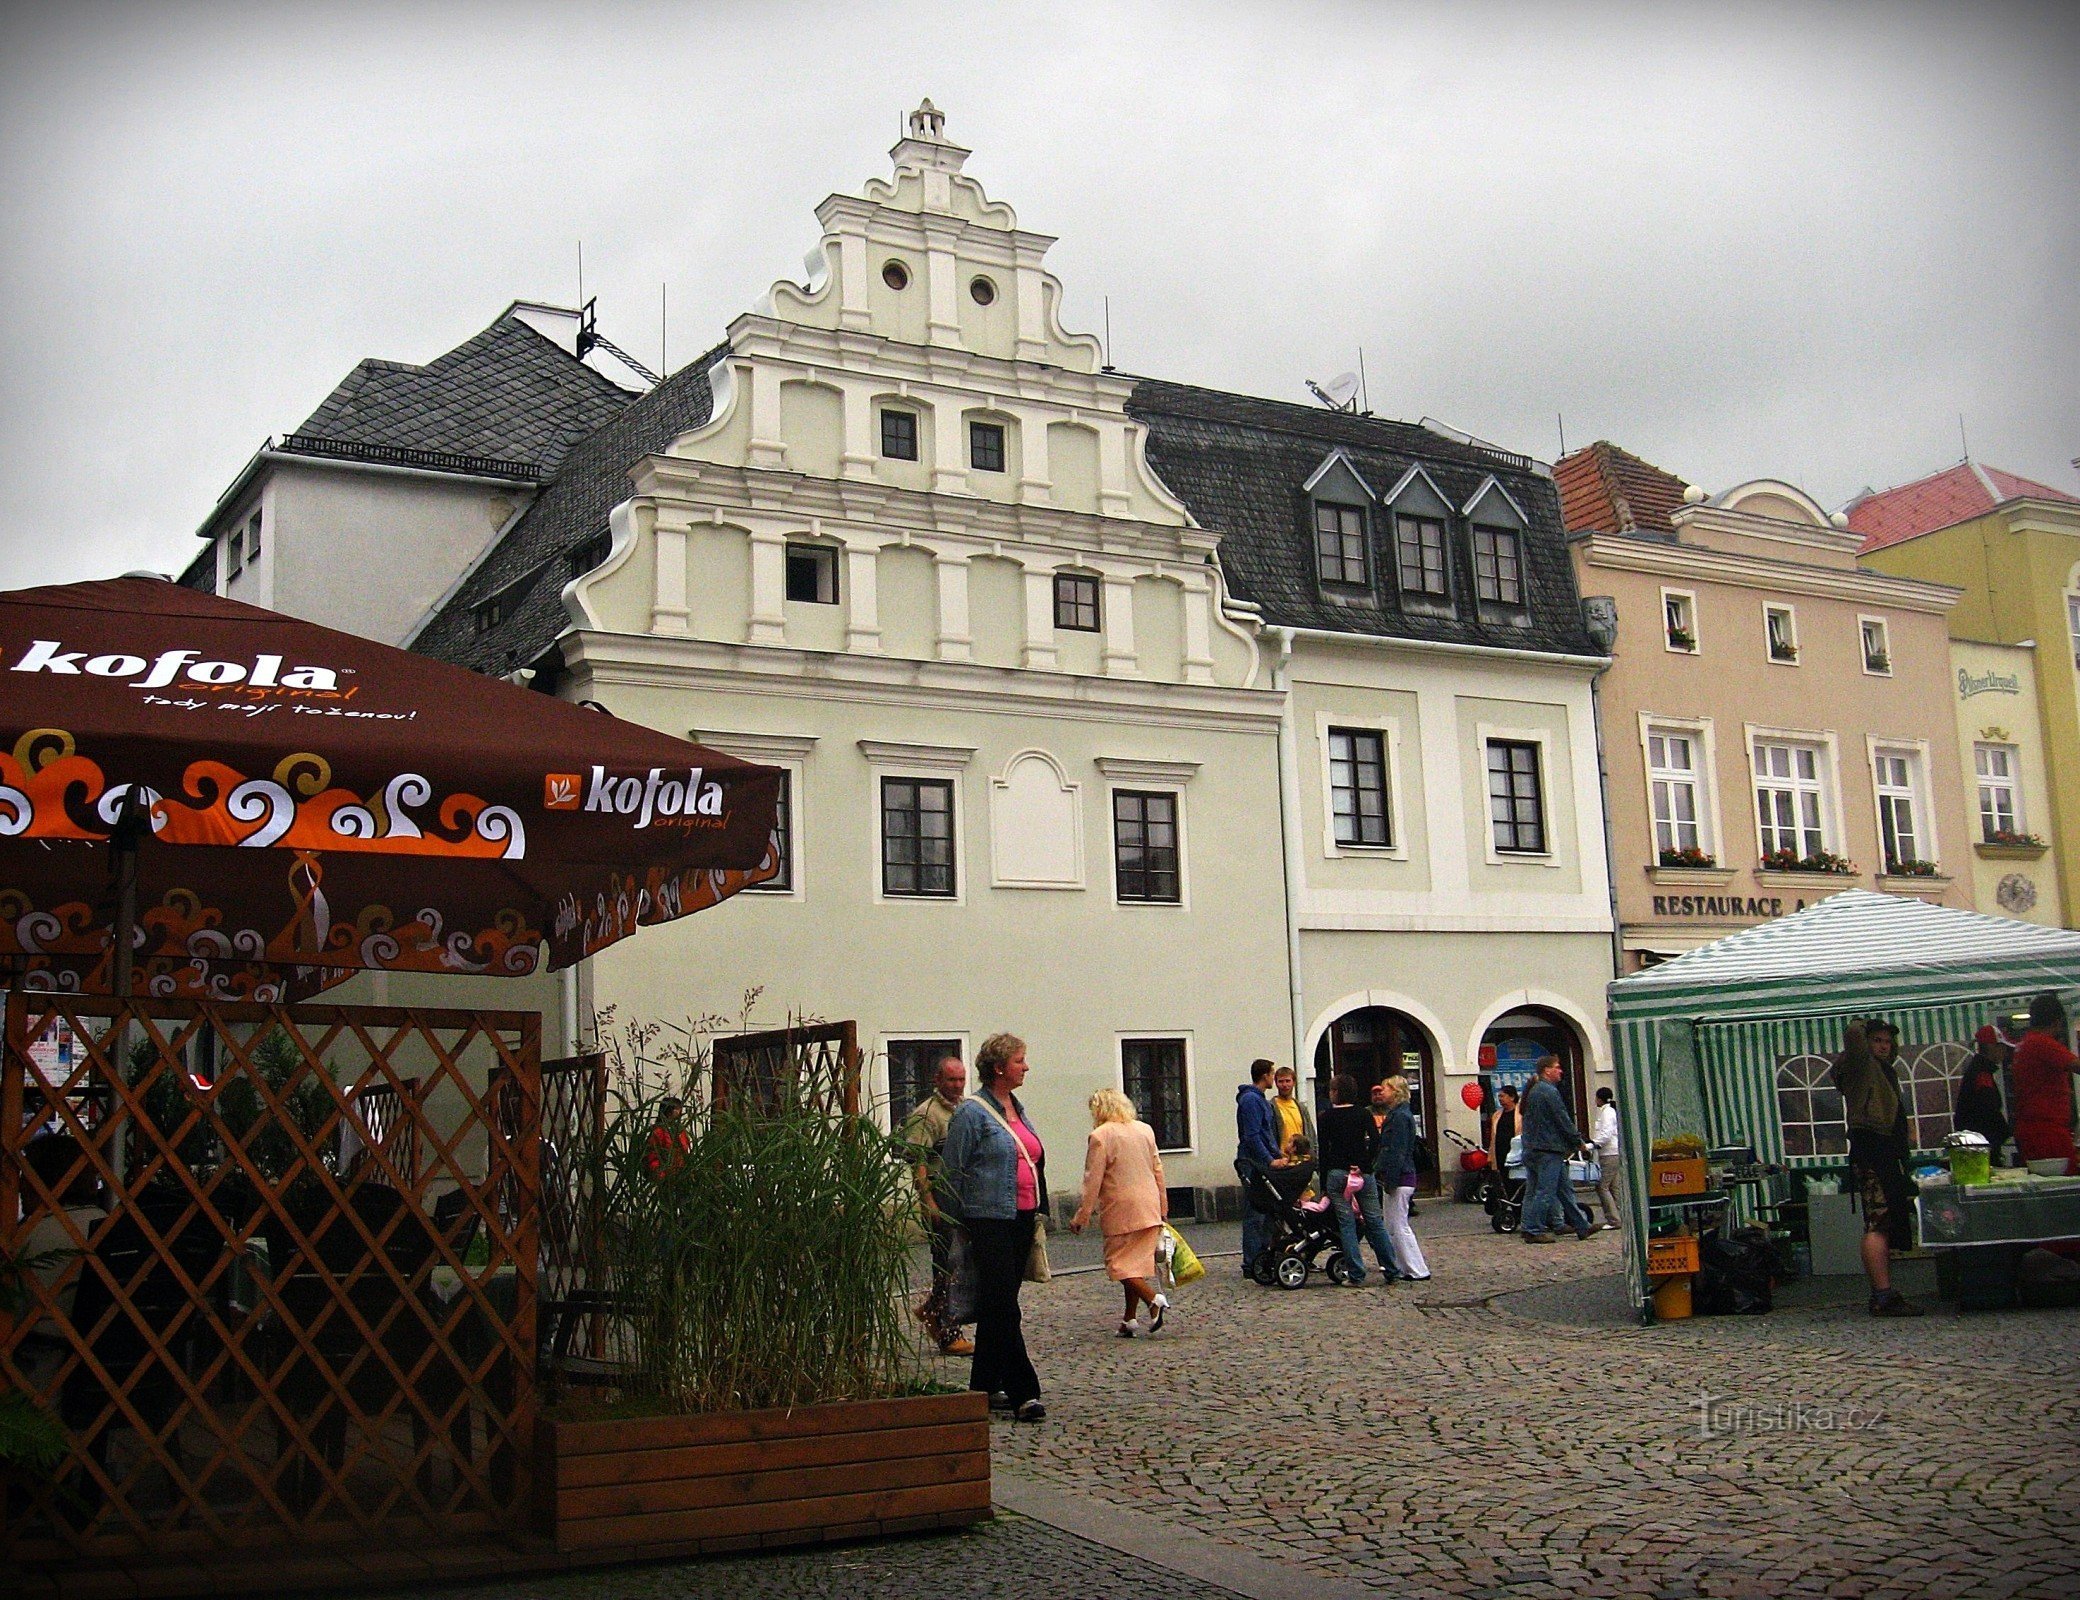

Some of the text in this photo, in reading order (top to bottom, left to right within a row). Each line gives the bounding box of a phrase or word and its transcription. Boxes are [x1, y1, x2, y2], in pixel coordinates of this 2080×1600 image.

[11, 640, 338, 691] kofola
[143, 695, 208, 710] tady
[178, 683, 360, 701] original
[584, 765, 723, 829] kofola
[653, 811, 732, 837] original
[1653, 895, 1783, 917] RESTAURACE
